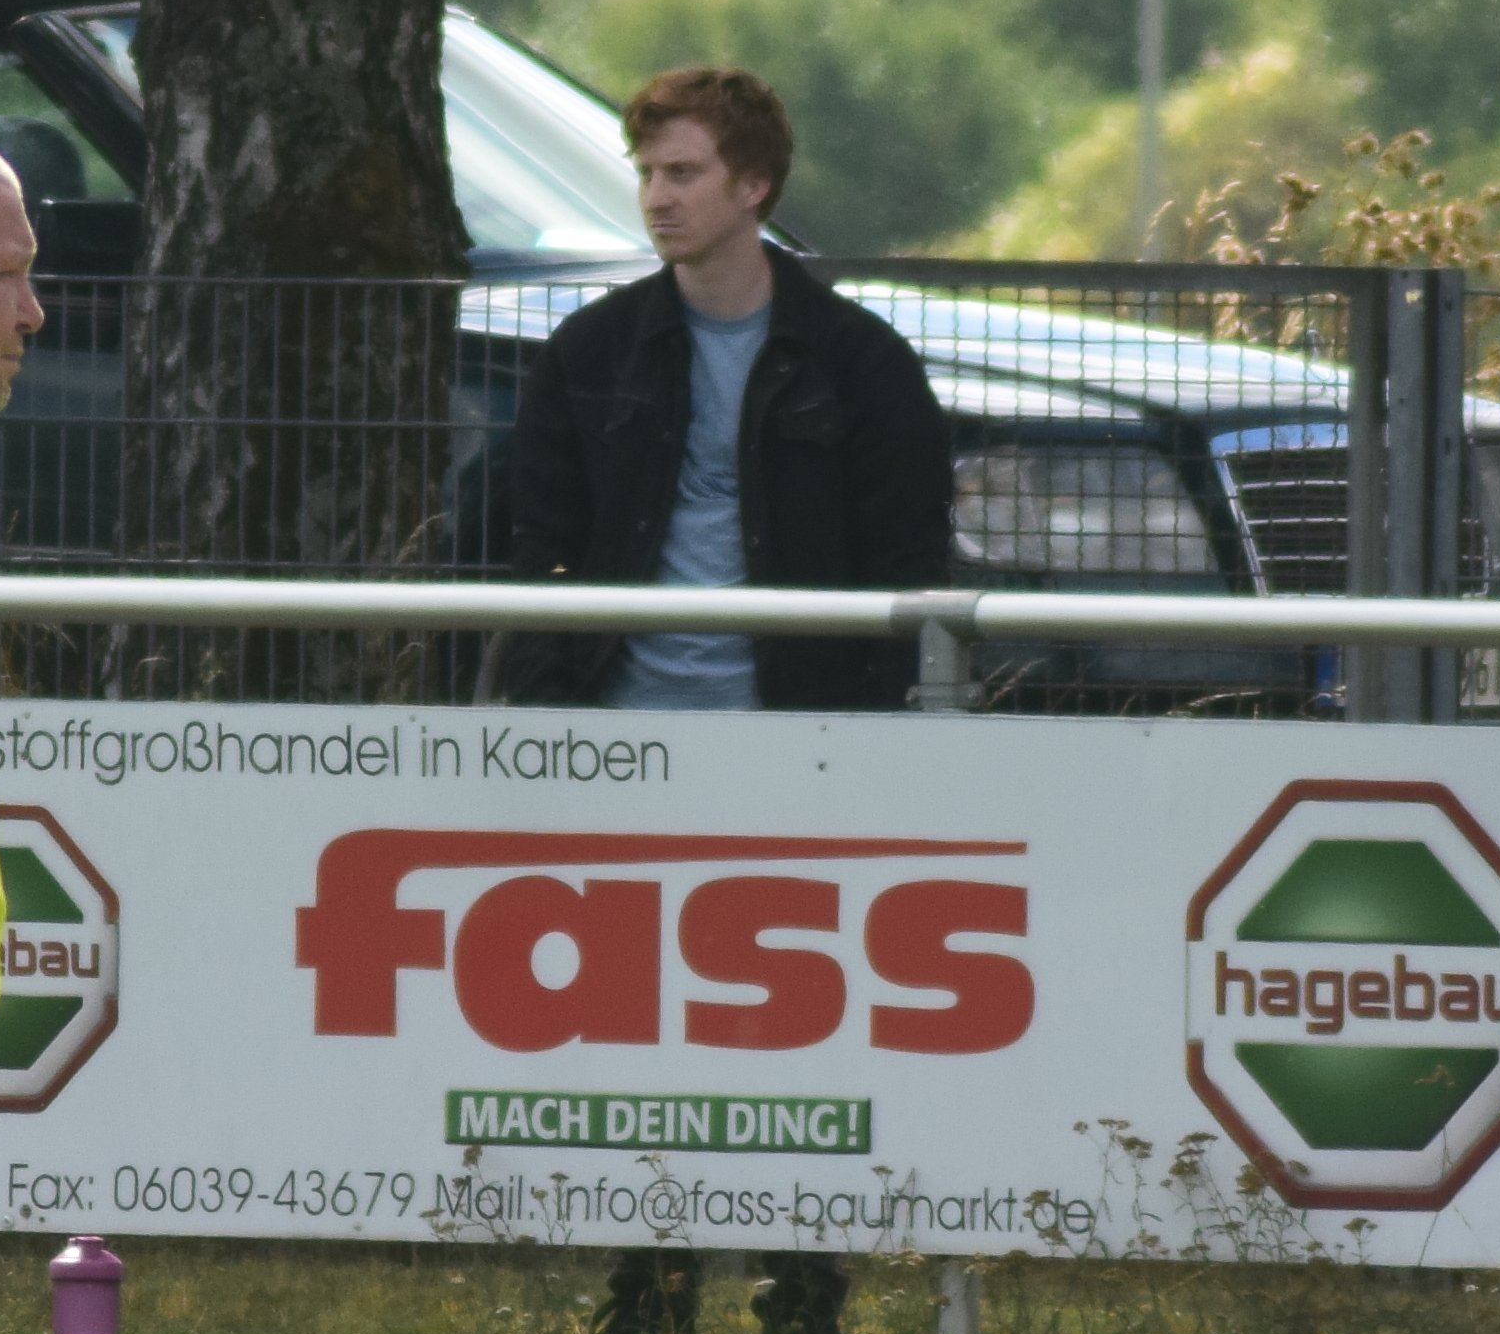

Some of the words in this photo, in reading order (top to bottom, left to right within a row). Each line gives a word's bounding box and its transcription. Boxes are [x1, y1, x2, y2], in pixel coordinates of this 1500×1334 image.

[421, 725, 462, 778] in
[482, 727, 669, 783] Karben
[294, 827, 1036, 1056] fass
[459, 1097, 589, 1141] MACH
[606, 1100, 711, 1144] DEIN
[726, 1103, 860, 1148] DING!
[8, 1163, 94, 1210] Fax:
[114, 1165, 416, 1218] 06039-43679
